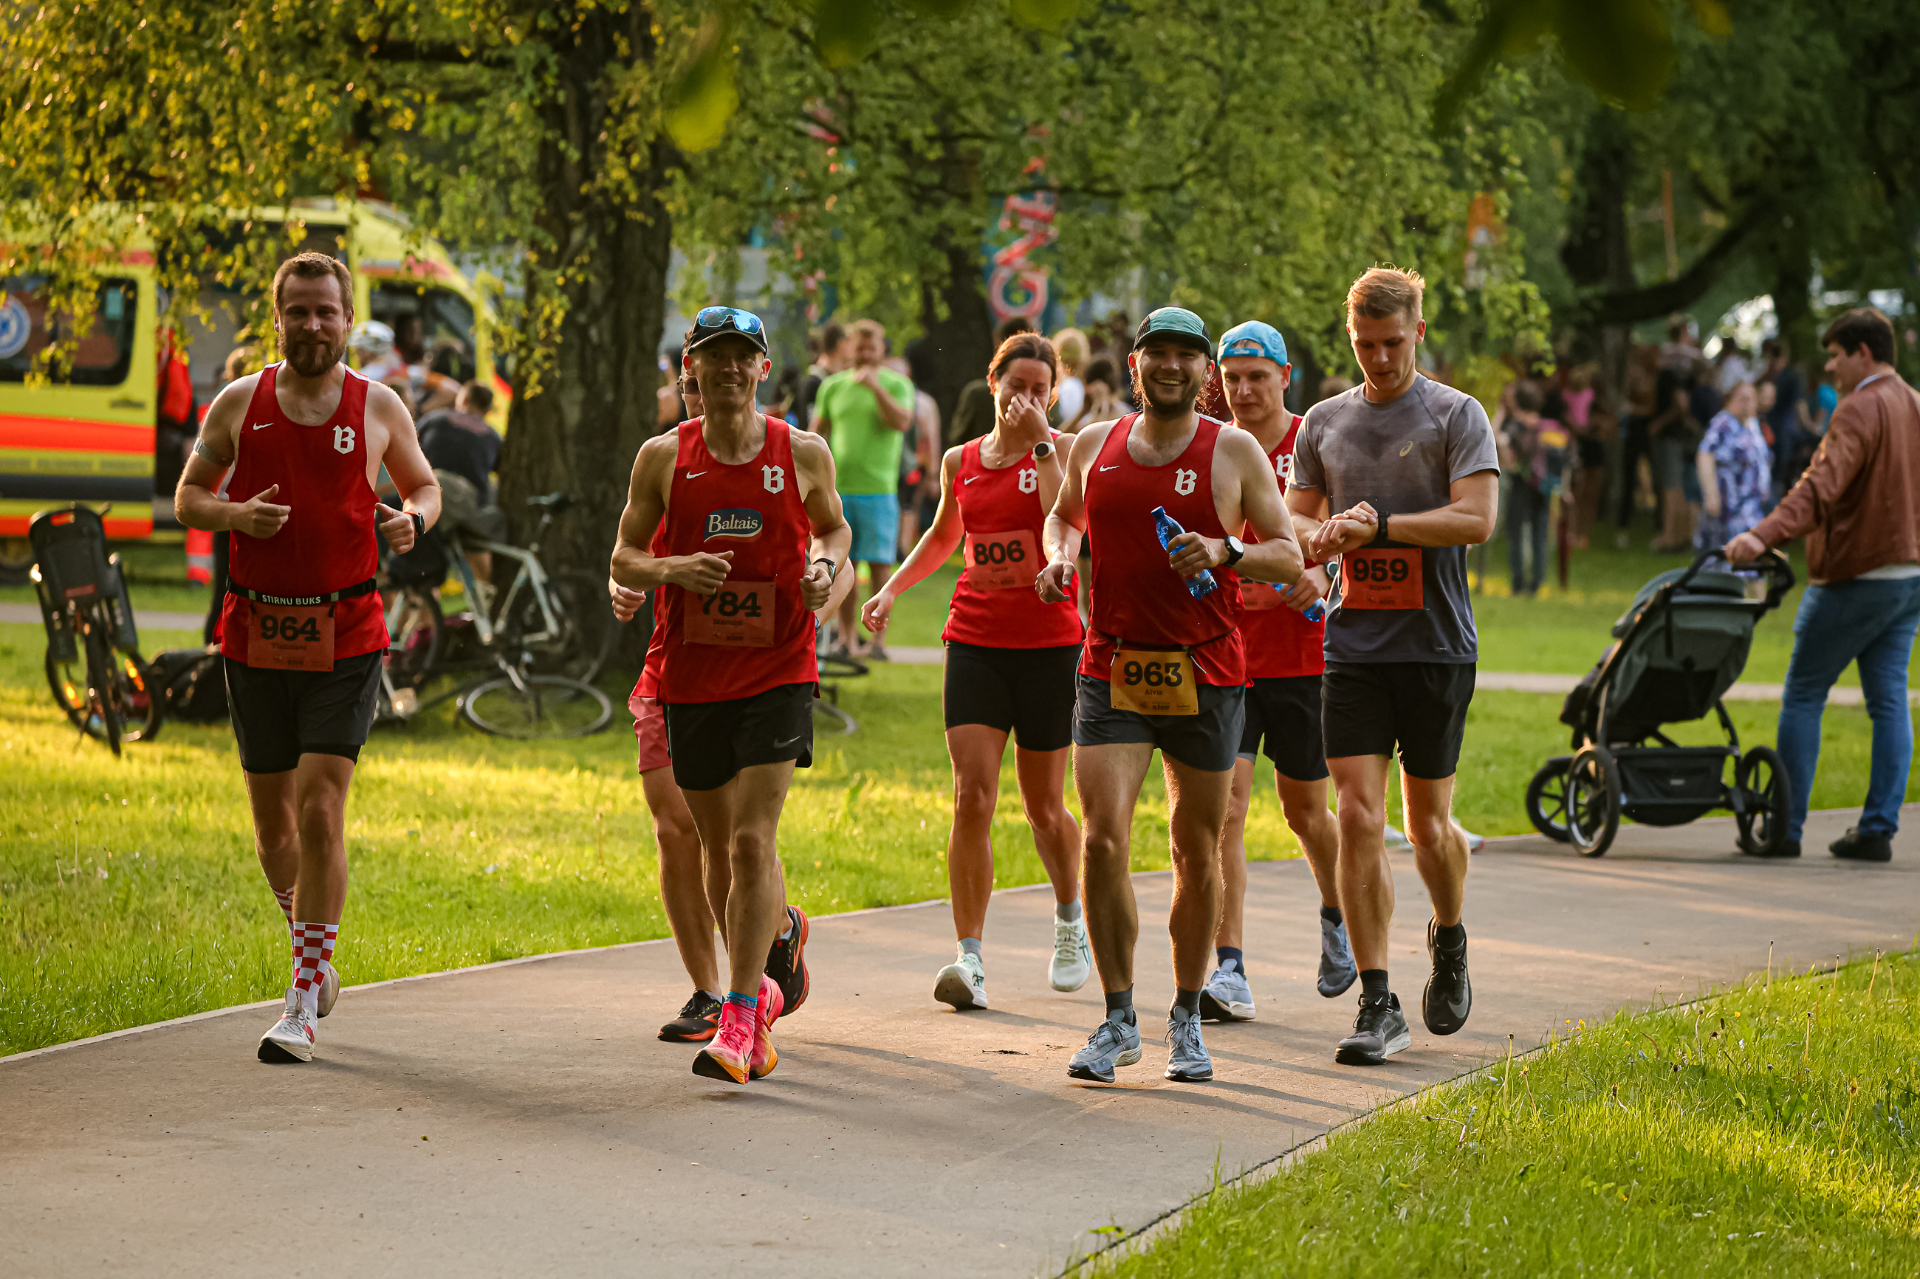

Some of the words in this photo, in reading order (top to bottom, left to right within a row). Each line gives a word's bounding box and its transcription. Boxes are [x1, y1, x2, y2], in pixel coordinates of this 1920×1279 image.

[333, 425, 356, 455] B
[761, 464, 785, 495] B
[1174, 467, 1198, 496] B
[708, 513, 759, 533] Baltais
[974, 540, 1025, 565] 806
[1352, 557, 1409, 583] 959
[262, 594, 293, 605] STIRNU
[295, 596, 321, 605] BUKS
[697, 591, 762, 618] 784
[260, 614, 321, 642] 964
[1123, 660, 1183, 687] 963
